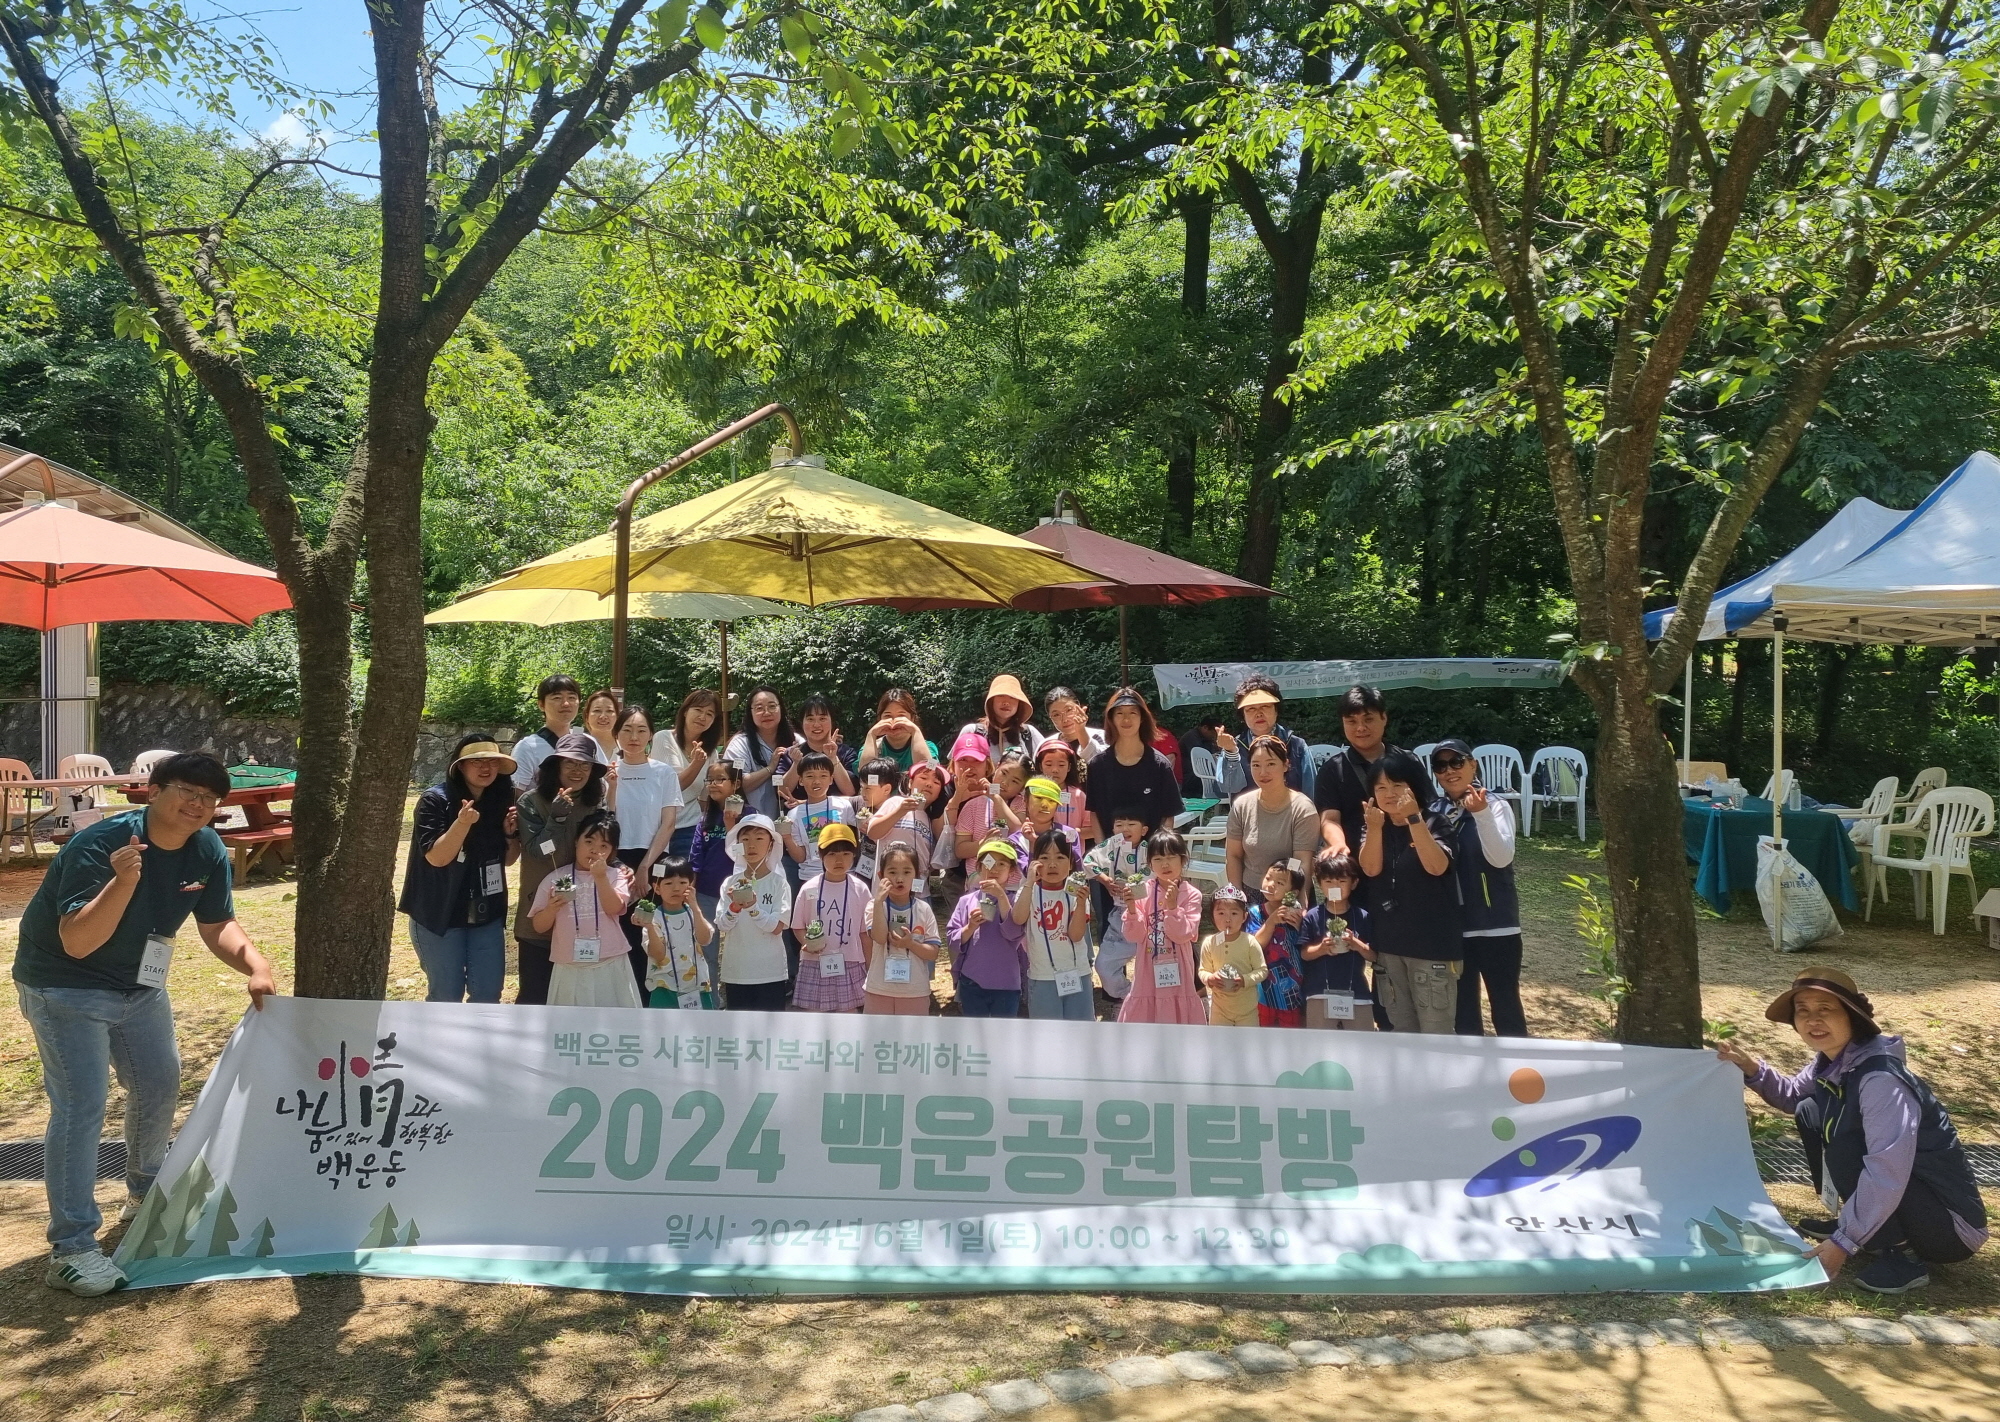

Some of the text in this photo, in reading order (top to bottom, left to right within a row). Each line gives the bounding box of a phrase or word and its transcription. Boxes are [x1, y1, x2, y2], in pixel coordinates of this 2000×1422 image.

[554, 1032, 991, 1077] 백운동 사회복지분과와 함께하는
[538, 1086, 1365, 1200] 2024 백운공원탐방
[316, 1150, 406, 1190] 백운동
[666, 1214, 737, 1250] 일시:
[748, 1217, 863, 1251] 2024년
[874, 1219, 924, 1252] 6월
[939, 1219, 1042, 1253] 1일(토)
[1055, 1224, 1151, 1251] 10:00
[1192, 1226, 1291, 1251] 12:30
[1505, 1214, 1641, 1237] 안산시
